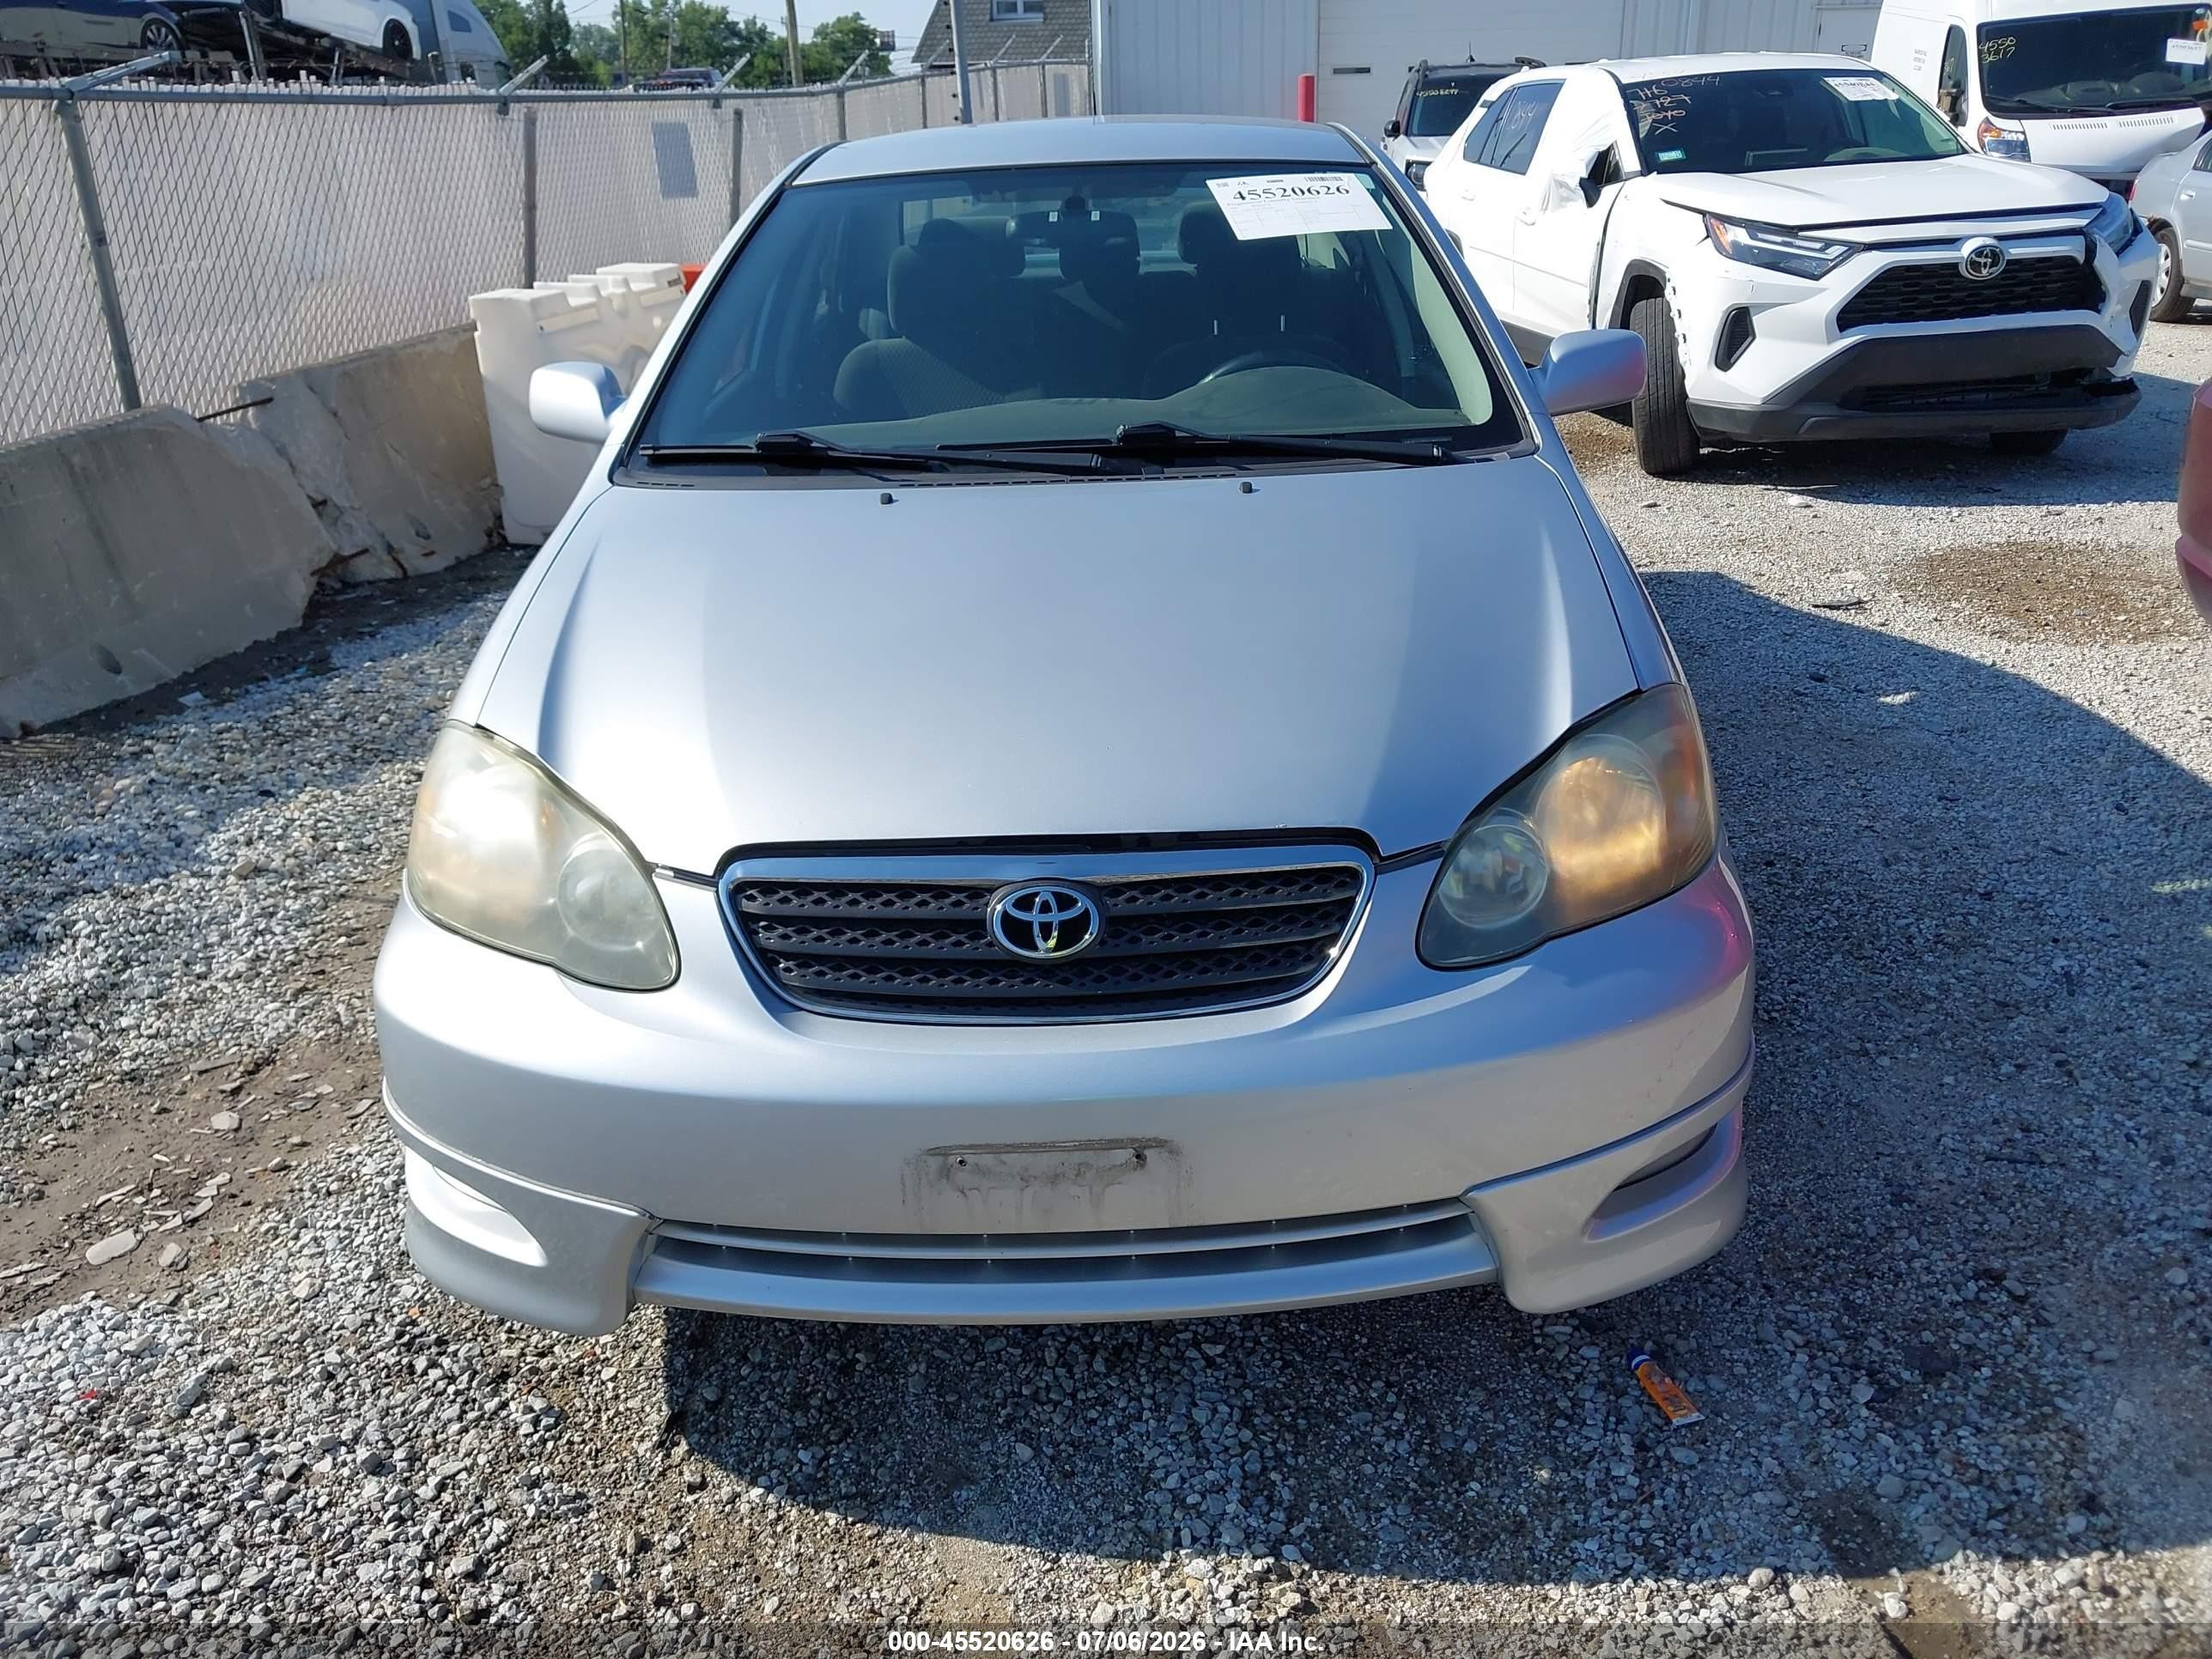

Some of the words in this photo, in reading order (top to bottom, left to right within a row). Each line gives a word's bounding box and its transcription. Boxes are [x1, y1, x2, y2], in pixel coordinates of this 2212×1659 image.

[1978, 36, 2016, 52] 4550
[1981, 46, 2015, 64] 3617
[1233, 185, 1350, 201] 45520626
